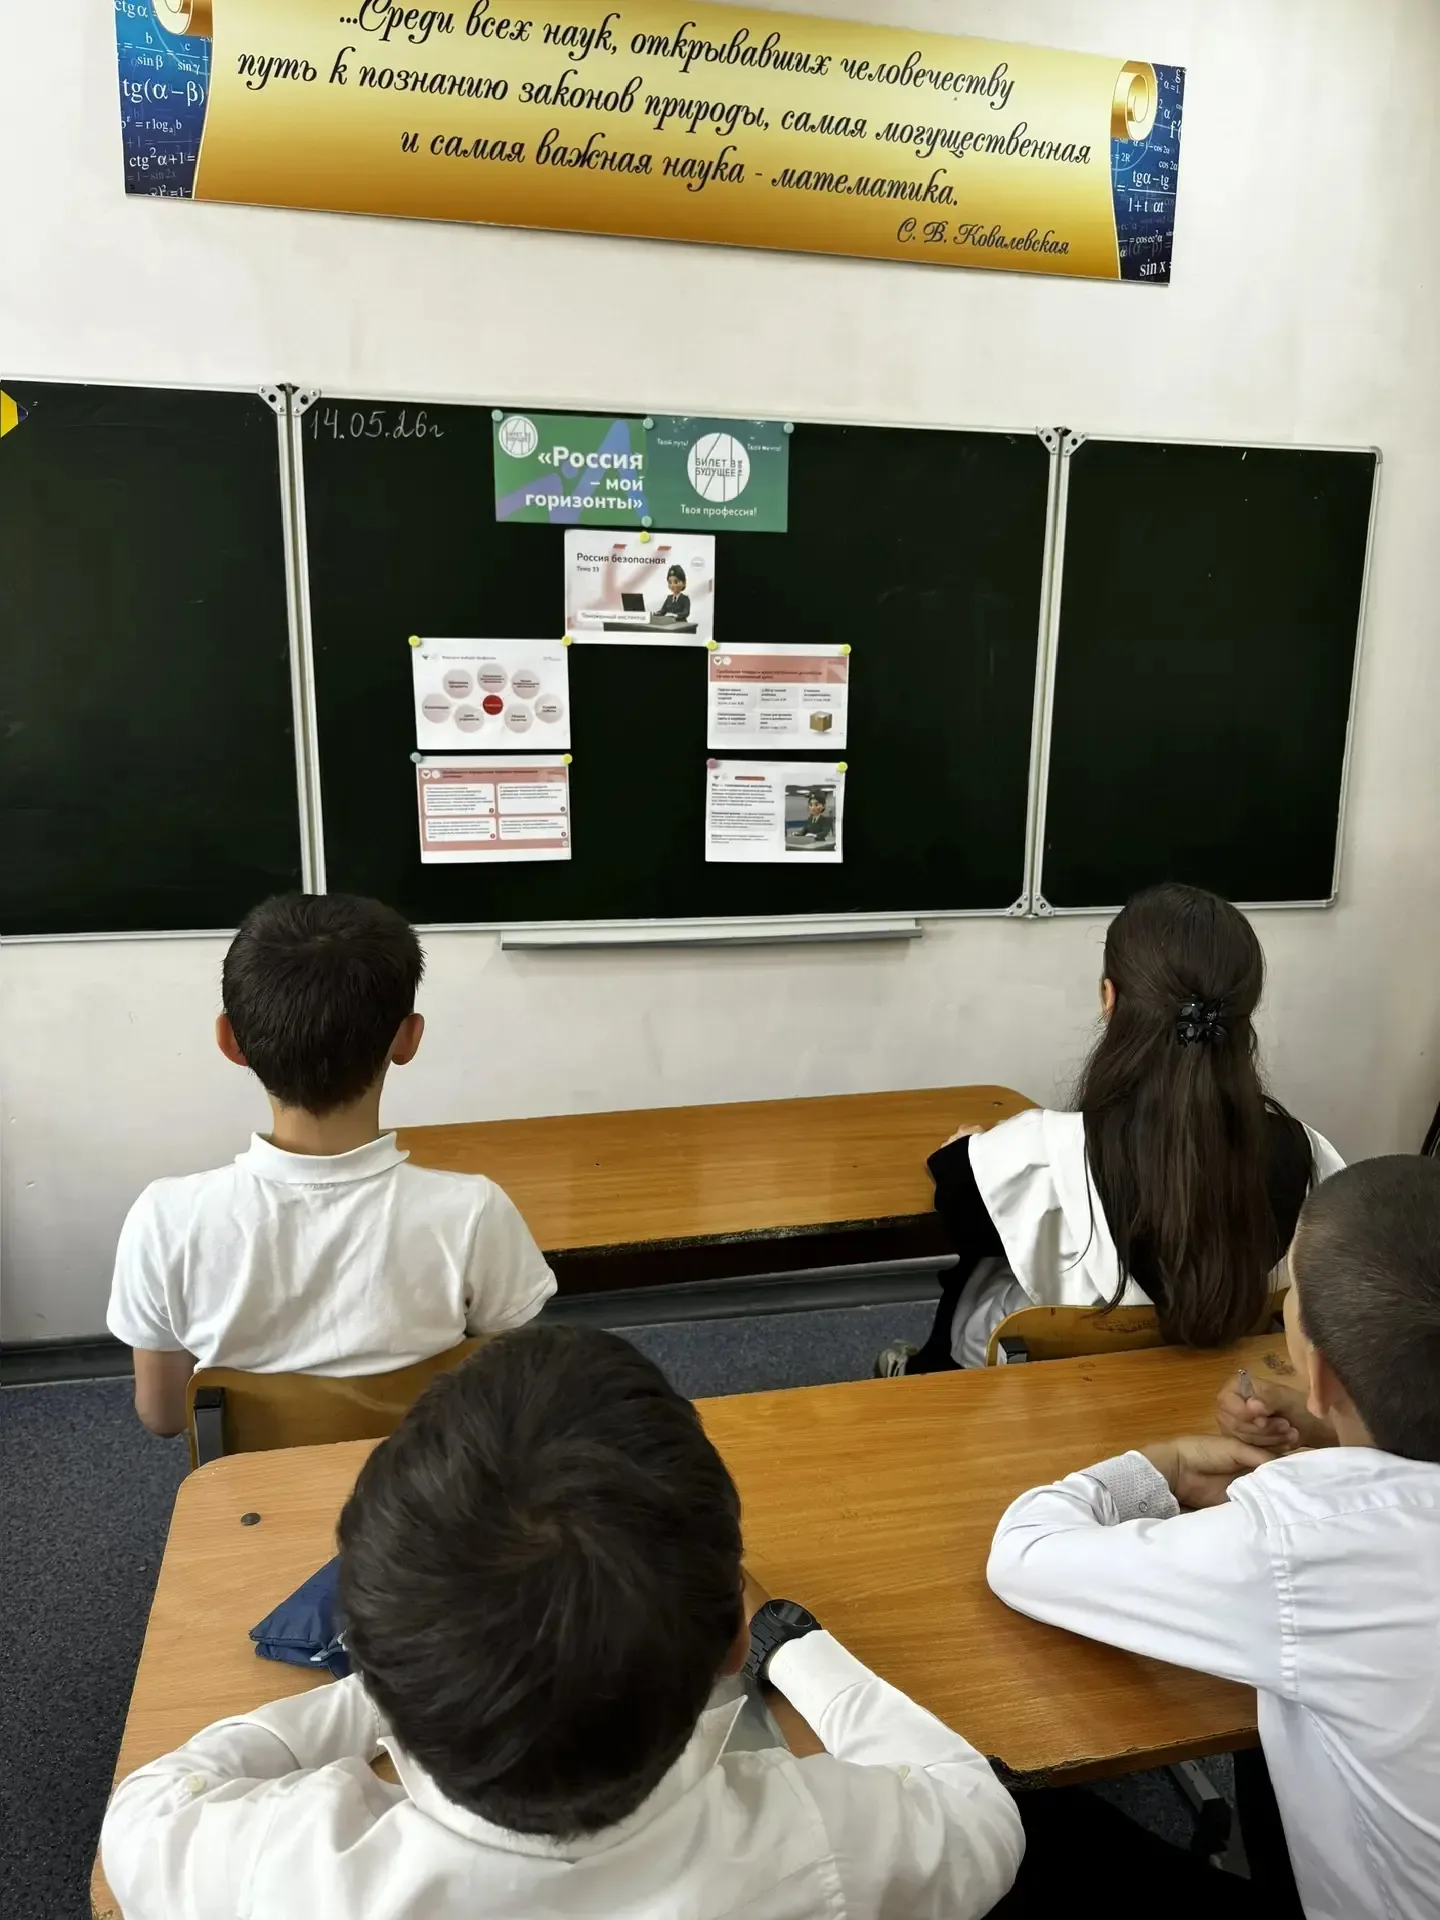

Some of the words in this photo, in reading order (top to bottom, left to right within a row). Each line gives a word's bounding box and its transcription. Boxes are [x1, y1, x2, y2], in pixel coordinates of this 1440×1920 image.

[339, 0, 455, 44] ...Среди
[466, 0, 533, 42] всех
[543, 12, 621, 62] наук,
[630, 21, 830, 76] открывавших
[840, 50, 1016, 111] человечеству
[237, 53, 318, 91] путь
[328, 46, 356, 86] к
[359, 65, 509, 101] познанию
[518, 68, 644, 113] законов
[644, 94, 770, 136] природы,
[780, 110, 868, 139] самая
[875, 121, 1092, 164] могущественная
[401, 131, 420, 154] и
[430, 134, 526, 163] самая
[535, 128, 653, 175] важная
[662, 145, 745, 192] наука
[771, 168, 959, 206] математика.
[897, 217, 916, 244] С.
[923, 221, 948, 244] В.
[953, 223, 1070, 255] Ковалевская
[538, 446, 644, 470] «Россия
[695, 458, 727, 468] БИЛЕТ
[695, 467, 736, 478] БУДУЩЕЕ
[605, 476, 645, 492] мой
[525, 493, 643, 511] горизонты»
[681, 504, 701, 514] Твоя
[703, 505, 757, 519] профессия!
[576, 552, 609, 563] Россия
[611, 553, 667, 565] безопасная
